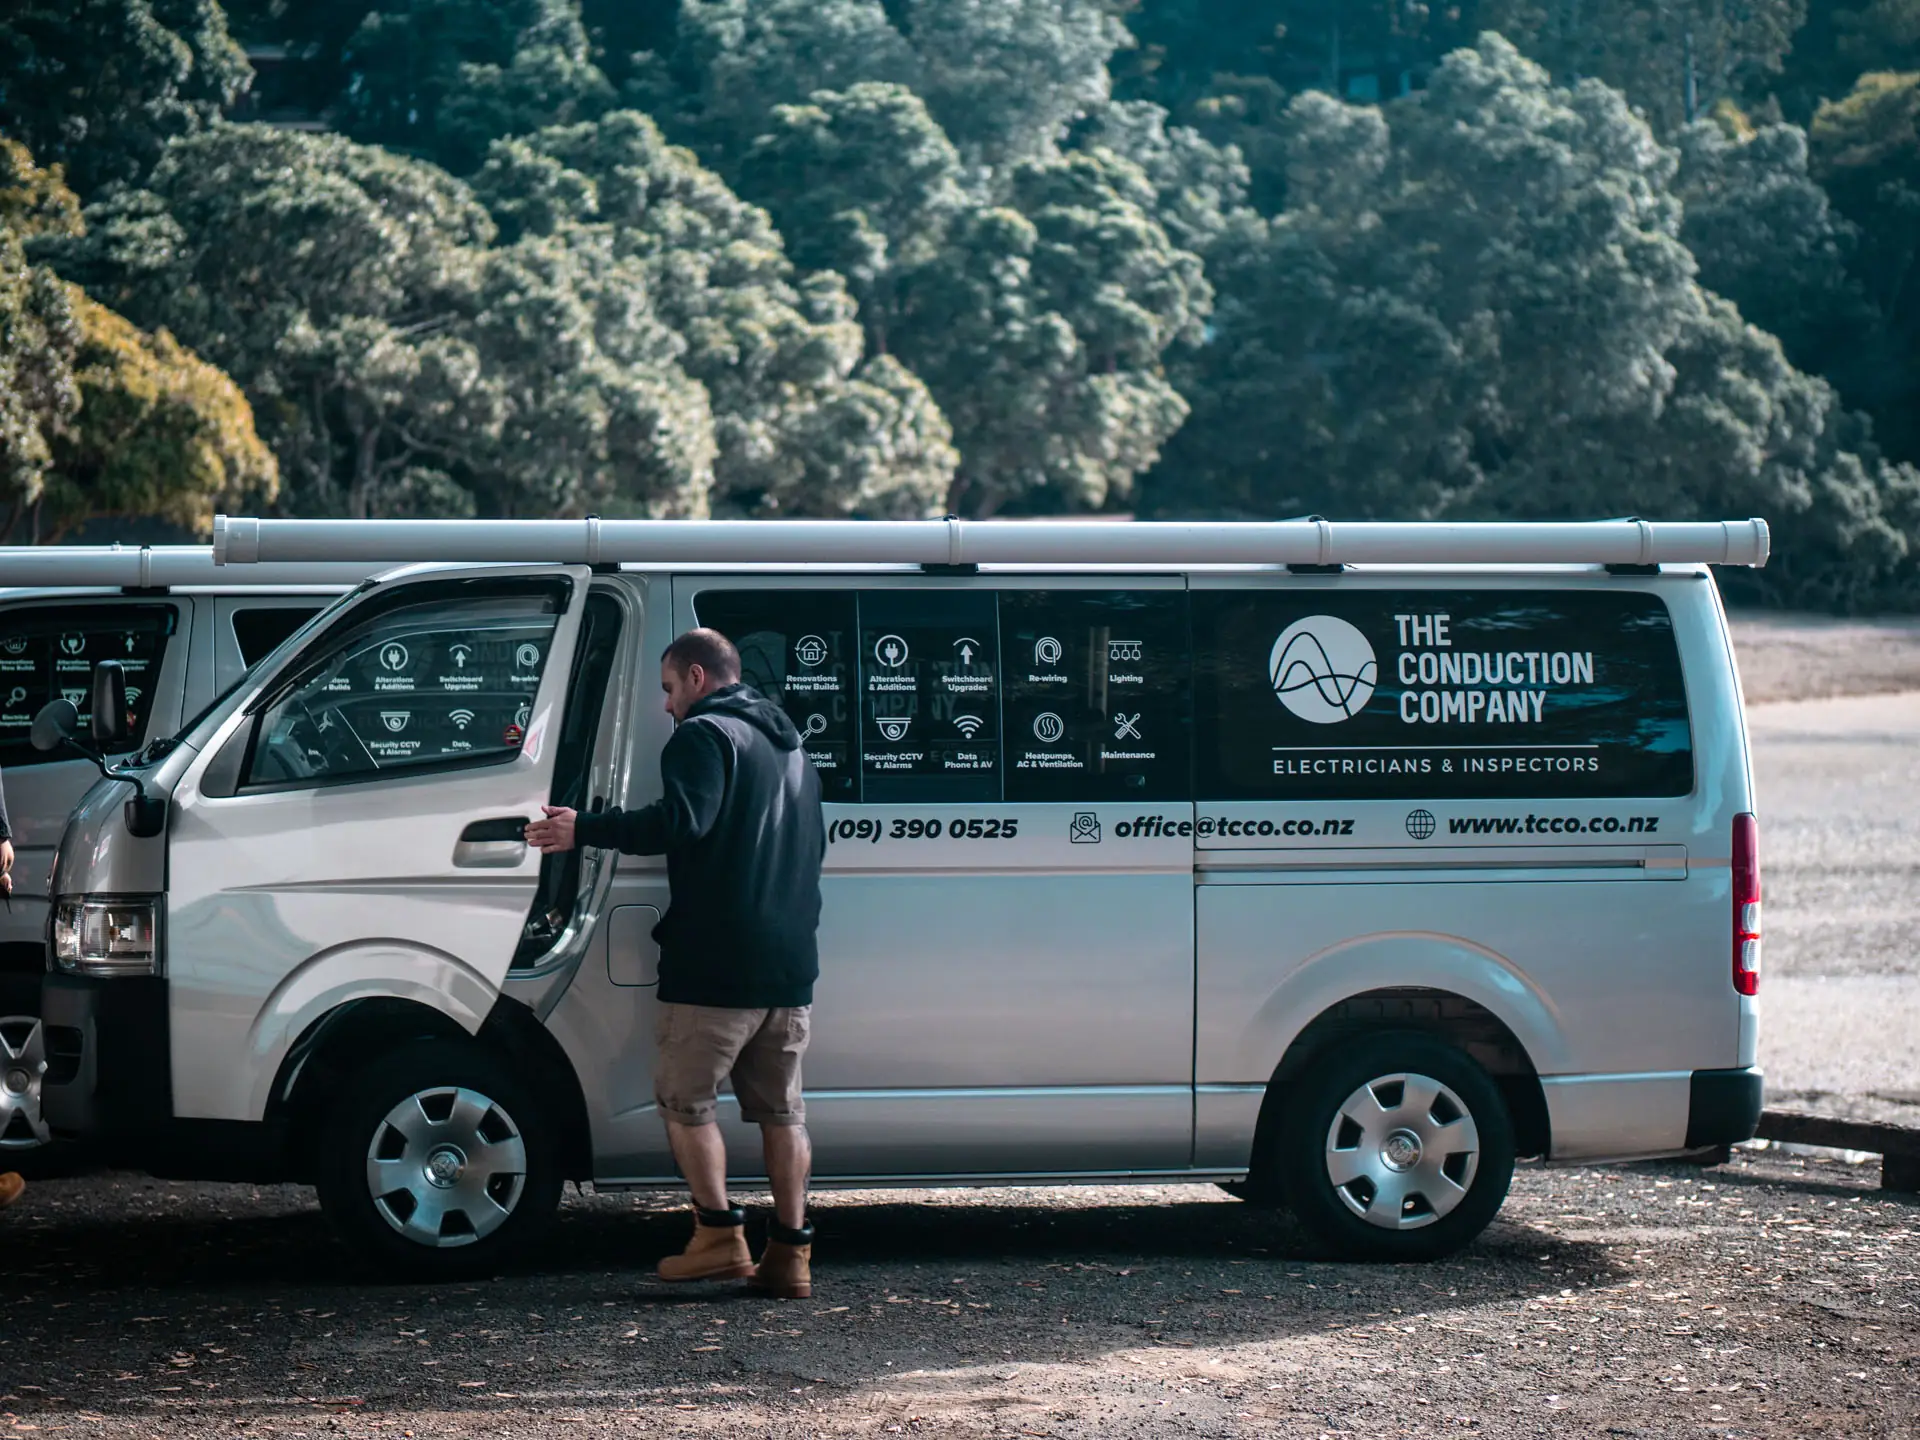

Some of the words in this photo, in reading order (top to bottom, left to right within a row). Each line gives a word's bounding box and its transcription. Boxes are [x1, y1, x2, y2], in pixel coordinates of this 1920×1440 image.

[1394, 615, 1451, 646] THE
[1399, 652, 1593, 684] CONDUCTION
[1029, 675, 1067, 683] Re-wiring
[1110, 675, 1143, 683] Lighting
[948, 684, 987, 692] Upgrades
[1400, 690, 1546, 723] COMPANY
[371, 742, 399, 750] Security
[808, 752, 832, 760] trical
[864, 753, 898, 762] Security
[1025, 752, 1075, 761] Heatpumps,
[1039, 760, 1083, 768] Ventilation
[1274, 759, 1431, 774] ELECTRICIANS
[1442, 759, 1453, 772] &
[1464, 758, 1598, 772] INSPECTORS
[1115, 816, 1354, 837] office@tcco.co.nz
[1449, 815, 1659, 834] www.tcco.co.nz
[828, 818, 882, 844] (09)
[889, 819, 941, 838] 390
[949, 819, 1018, 838] 0525
